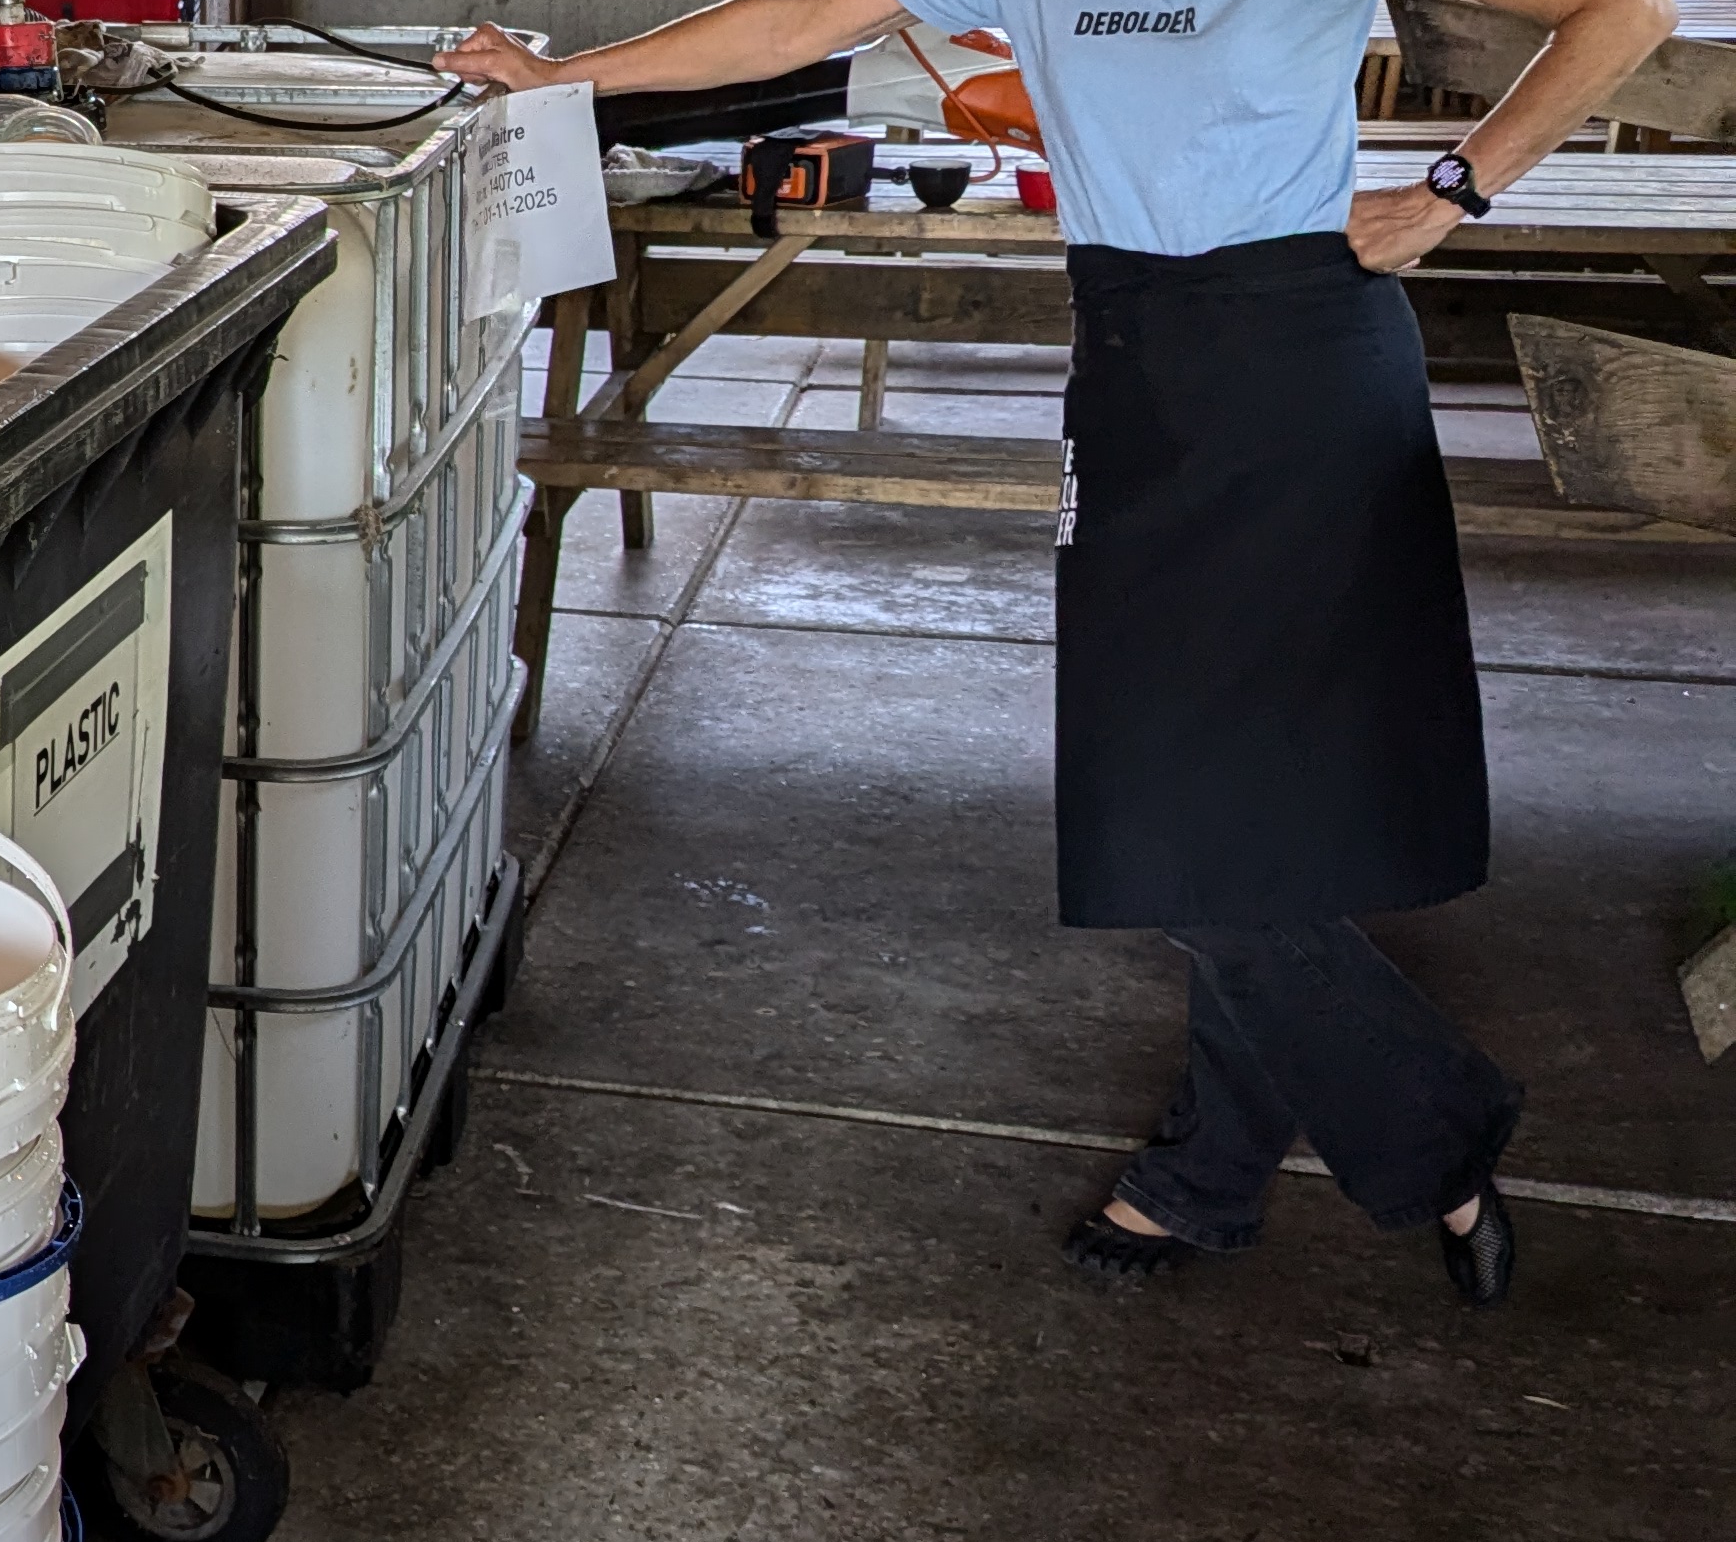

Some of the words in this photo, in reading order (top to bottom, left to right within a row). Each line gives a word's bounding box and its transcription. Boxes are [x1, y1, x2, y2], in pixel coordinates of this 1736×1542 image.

[1074, 7, 1196, 36] DEBOLDER
[490, 166, 535, 195] 140704
[33, 679, 121, 811] PLASTIC
